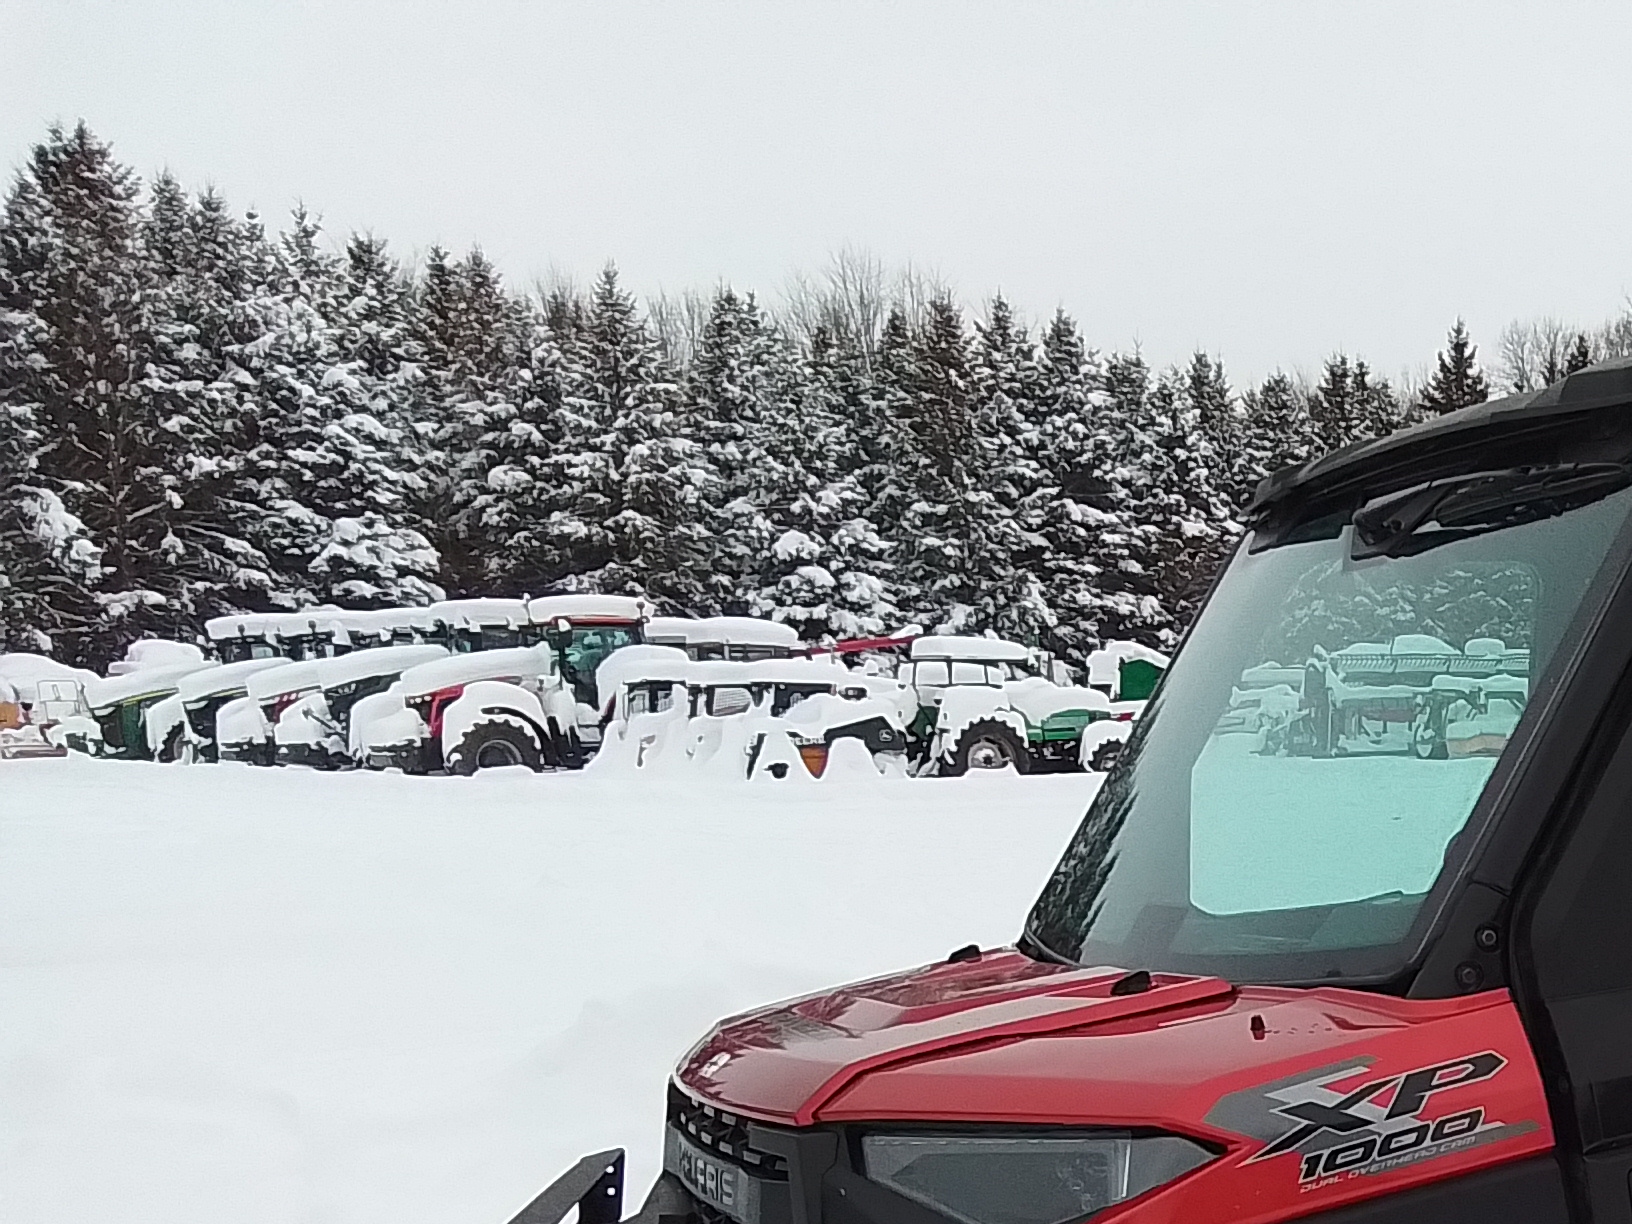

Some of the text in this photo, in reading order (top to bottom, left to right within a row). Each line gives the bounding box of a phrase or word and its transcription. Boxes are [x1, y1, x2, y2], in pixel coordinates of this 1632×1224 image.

[1234, 1049, 1509, 1169] XP
[1298, 1106, 1485, 1184] 1000
[1300, 1135, 1476, 1194] DUAL OVERHEAD CAM
